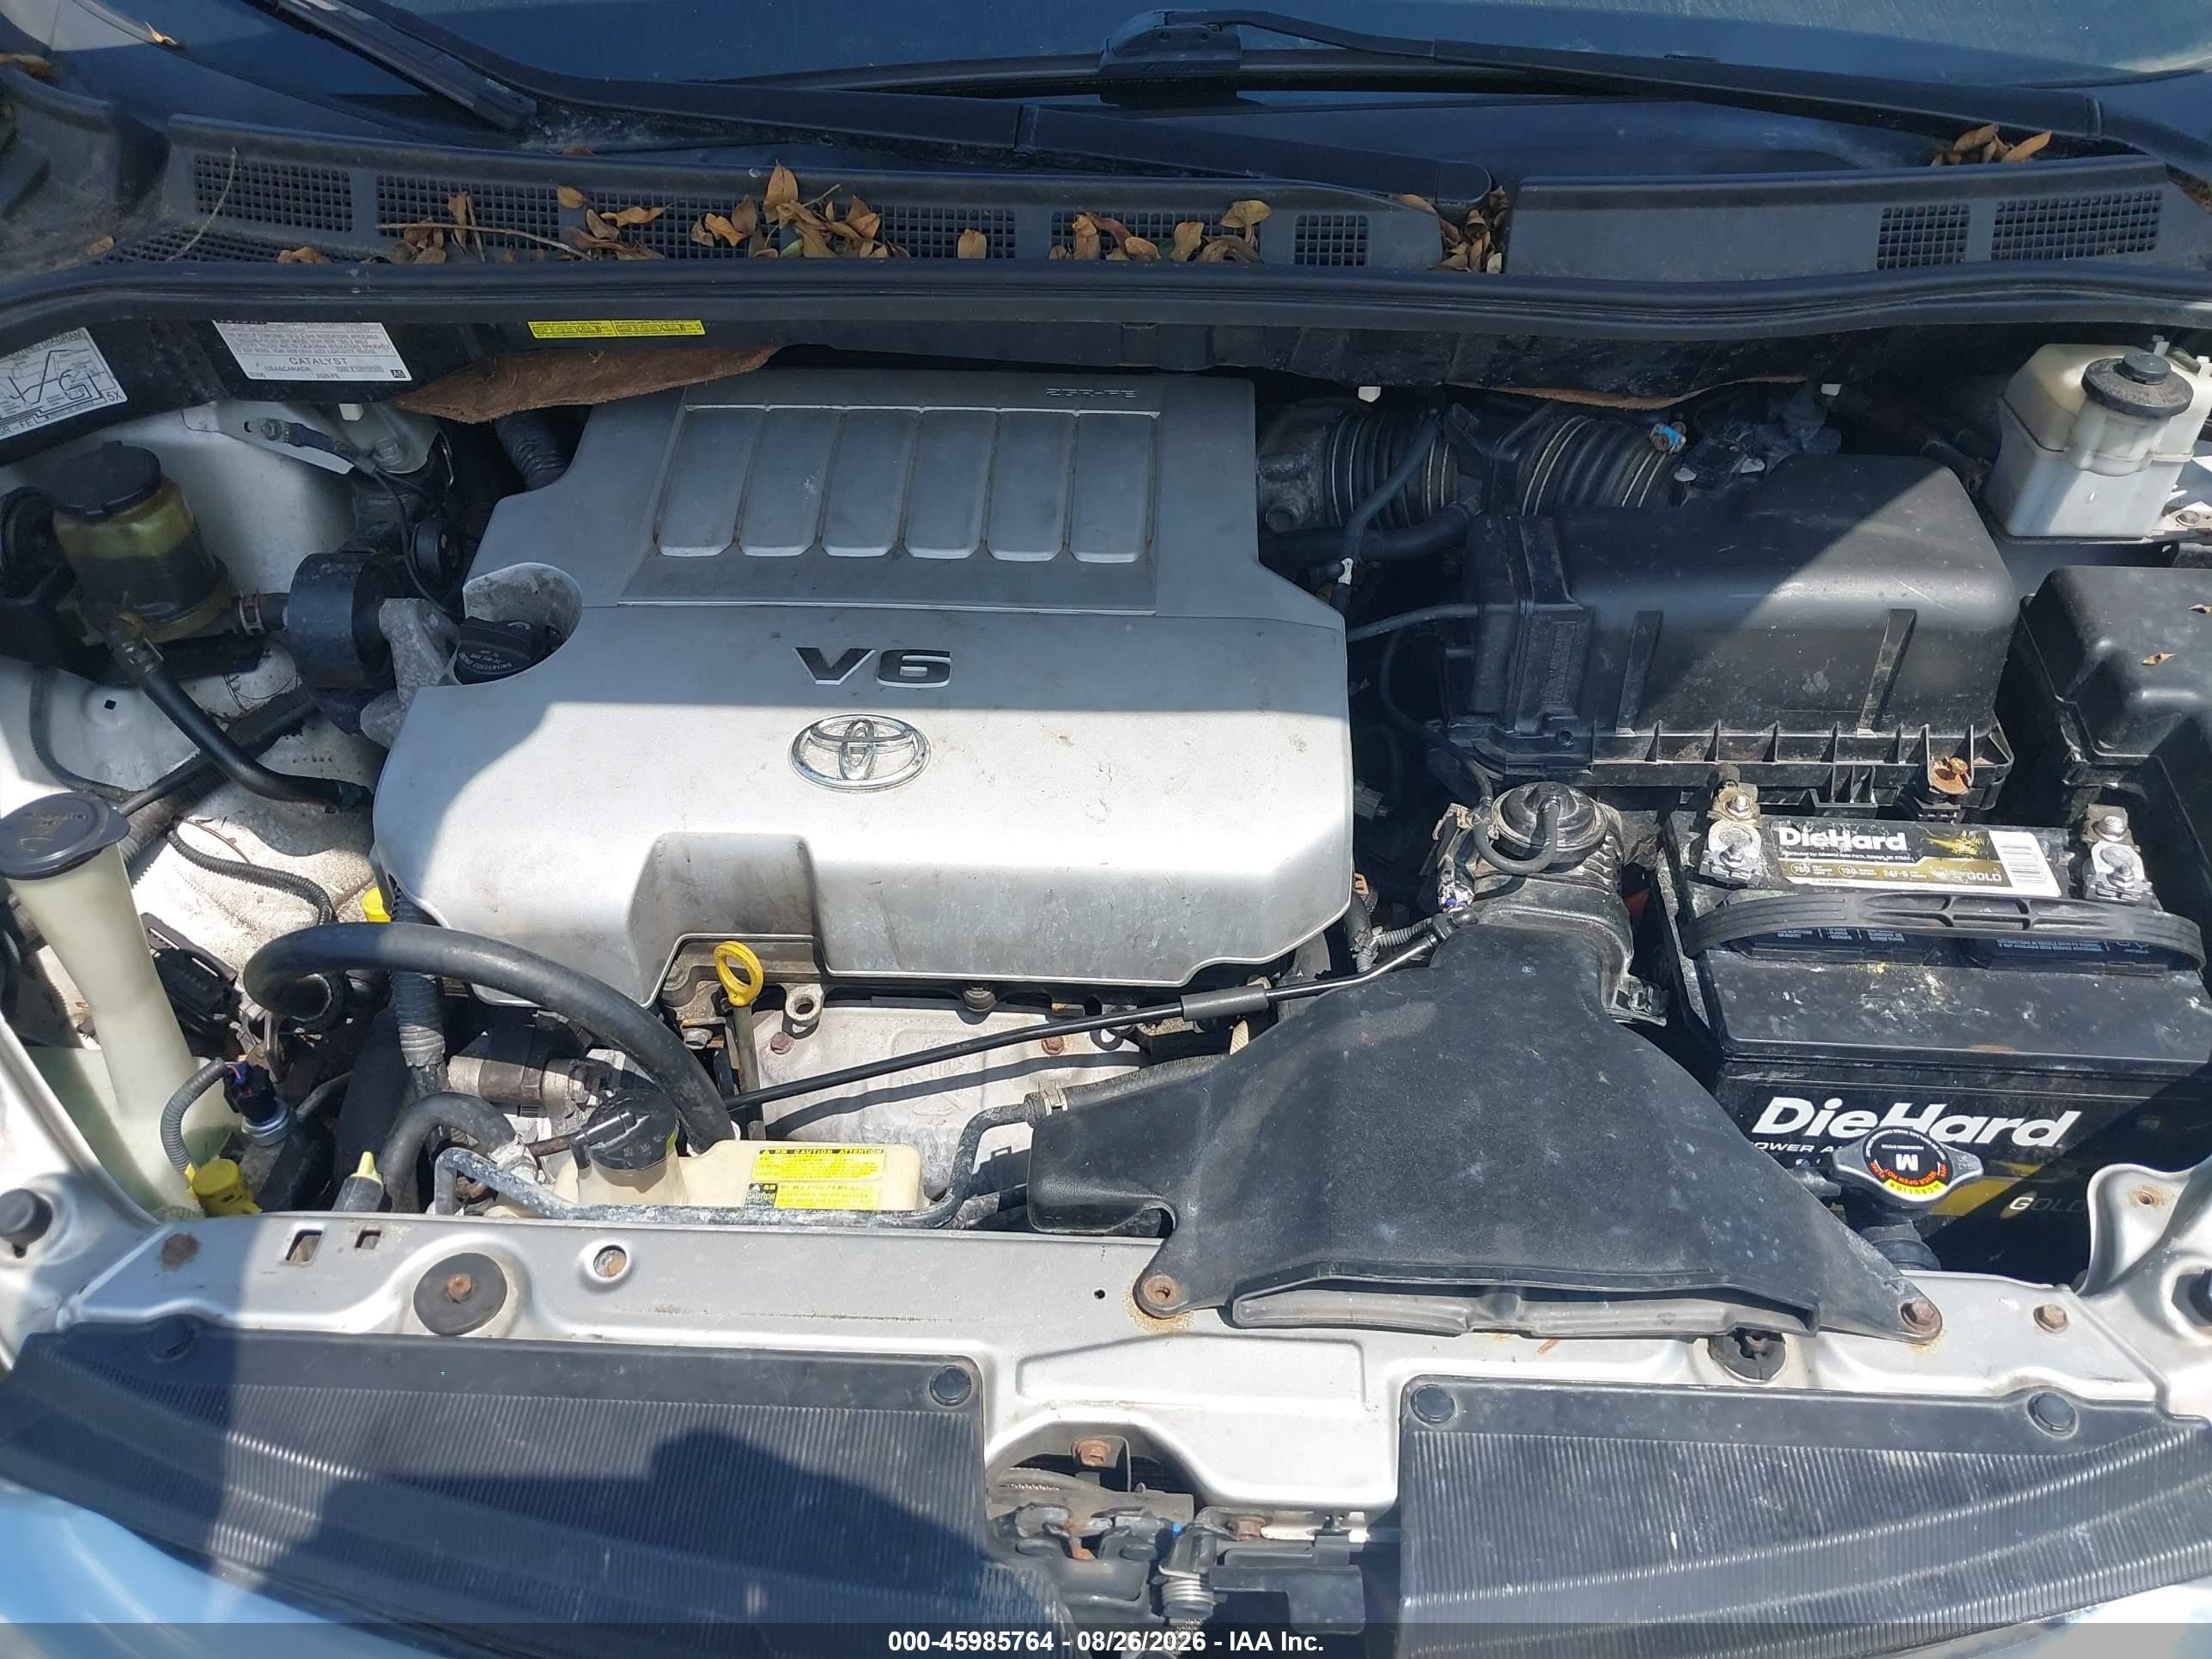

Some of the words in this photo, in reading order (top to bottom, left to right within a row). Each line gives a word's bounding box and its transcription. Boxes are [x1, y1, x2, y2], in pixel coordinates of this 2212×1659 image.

[106, 391, 123, 402] 5X
[793, 647, 952, 689] V6
[1779, 827, 1908, 851] DieHard
[1967, 872, 2002, 882] GOLD
[1752, 1097, 2082, 1148] DieHard
[1750, 1141, 1816, 1153] OWER
[1898, 1176, 1919, 1186] OPEN
[1888, 1182, 1936, 1195] CAUTION
[746, 1192, 775, 1202] CAUTION
[2009, 1196, 2089, 1212] GOLD
